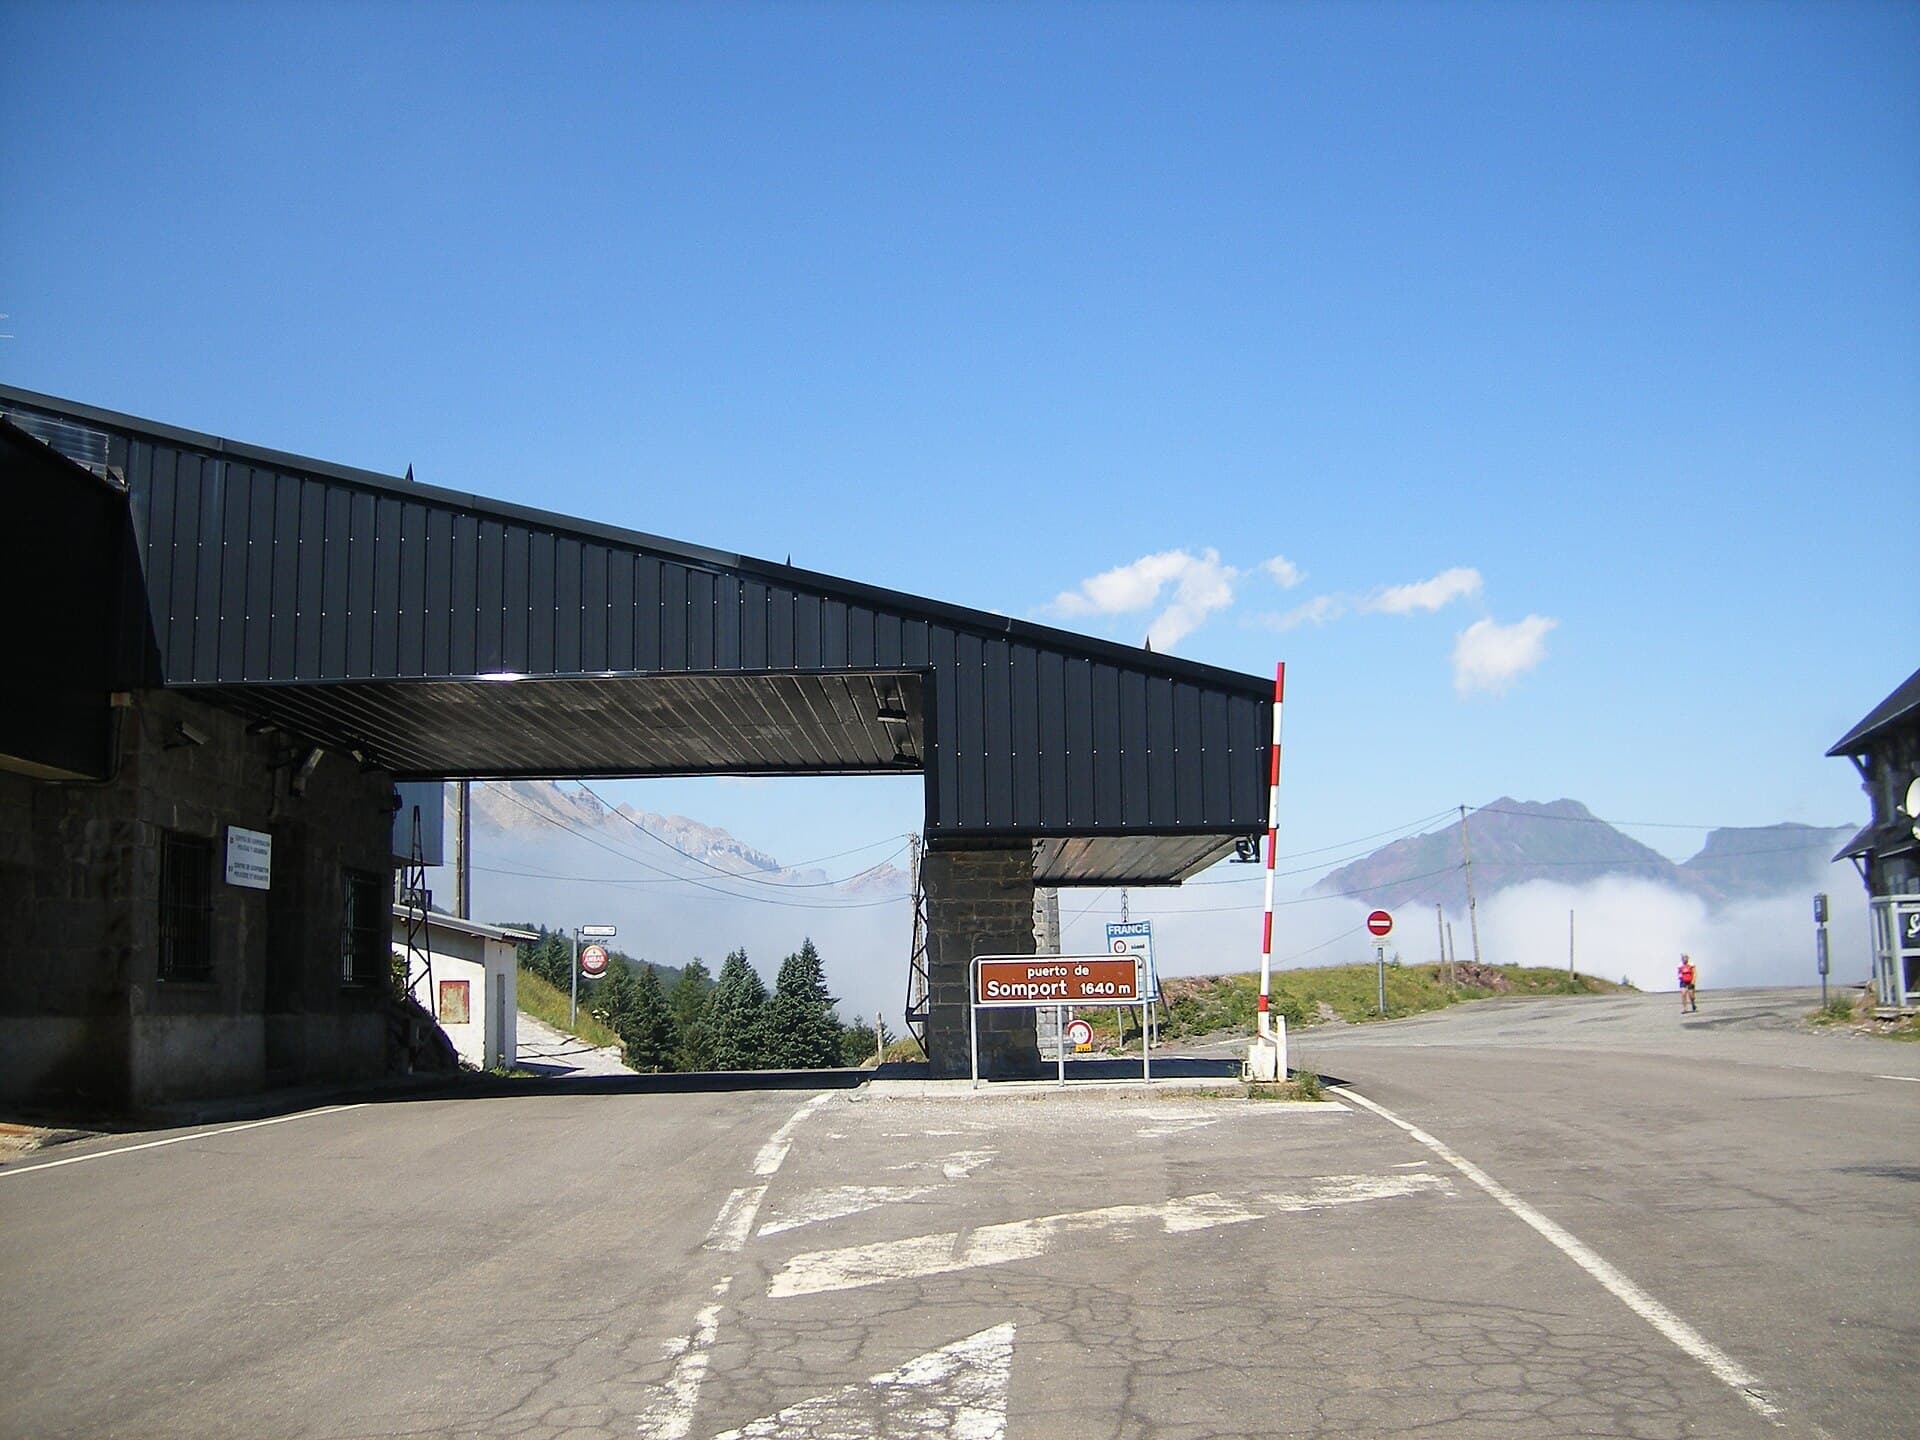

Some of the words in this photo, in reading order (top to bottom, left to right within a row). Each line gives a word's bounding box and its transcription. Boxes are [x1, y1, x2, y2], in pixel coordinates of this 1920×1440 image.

[1108, 923, 1149, 935] FRANCE
[1027, 966, 1068, 979] puerto
[1074, 965, 1090, 976] de
[987, 979, 1068, 999] Somport
[1080, 982, 1115, 995] 1640
[1118, 983, 1131, 994] m
